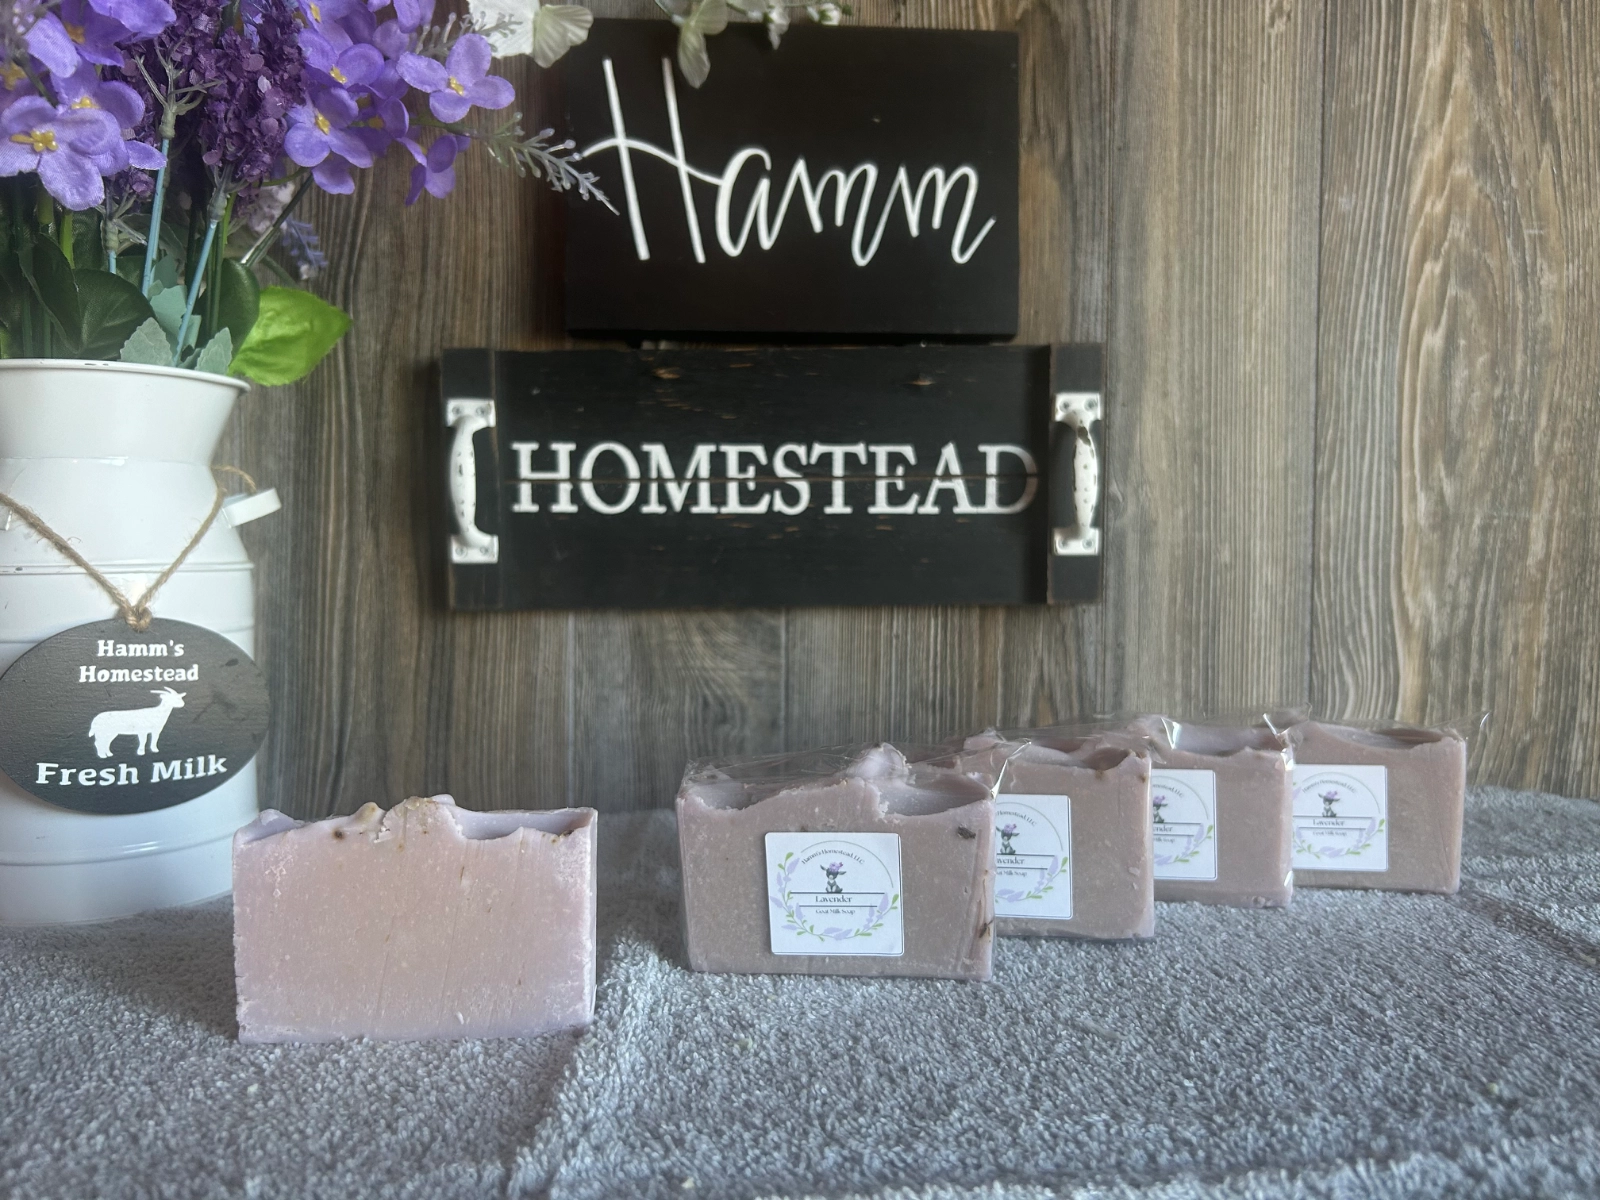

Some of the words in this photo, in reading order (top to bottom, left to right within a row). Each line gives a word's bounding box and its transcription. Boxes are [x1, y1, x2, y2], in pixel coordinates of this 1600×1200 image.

[583, 57, 996, 266] Hamm
[510, 442, 1039, 515] HOMESTEAD
[97, 640, 185, 657] Hamm's
[79, 664, 199, 683] Homestead
[36, 762, 139, 786] Fresh
[150, 755, 228, 783] Milk
[1313, 818, 1344, 826] Lavender
[853, 854, 865, 865] LLC
[815, 894, 852, 903] Lavender
